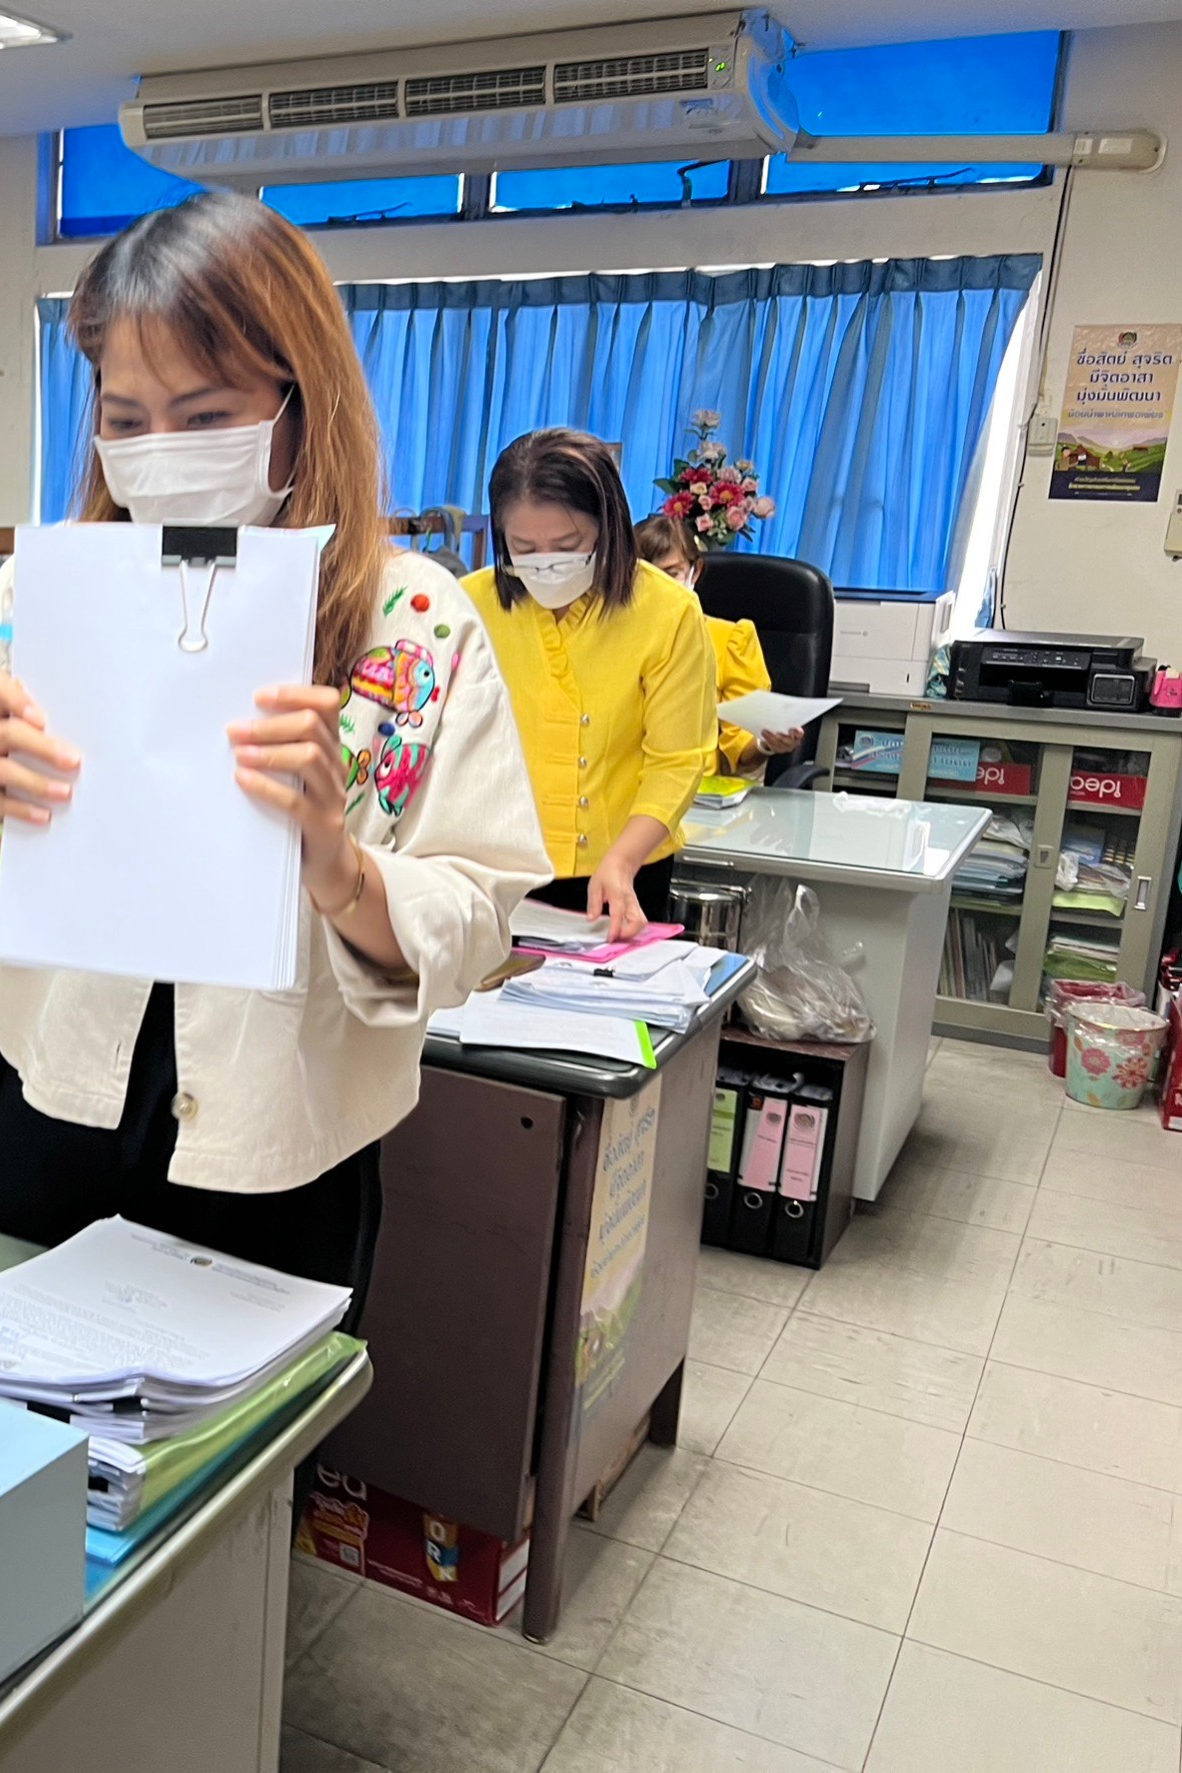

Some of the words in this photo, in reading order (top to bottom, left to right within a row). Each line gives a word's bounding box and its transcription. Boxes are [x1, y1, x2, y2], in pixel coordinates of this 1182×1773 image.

[1132, 351, 1173, 369] สุจริต
[1090, 369, 1153, 383] มีจิตอาสา
[1077, 384, 1161, 405] มุ่งมั่นพัฒนา
